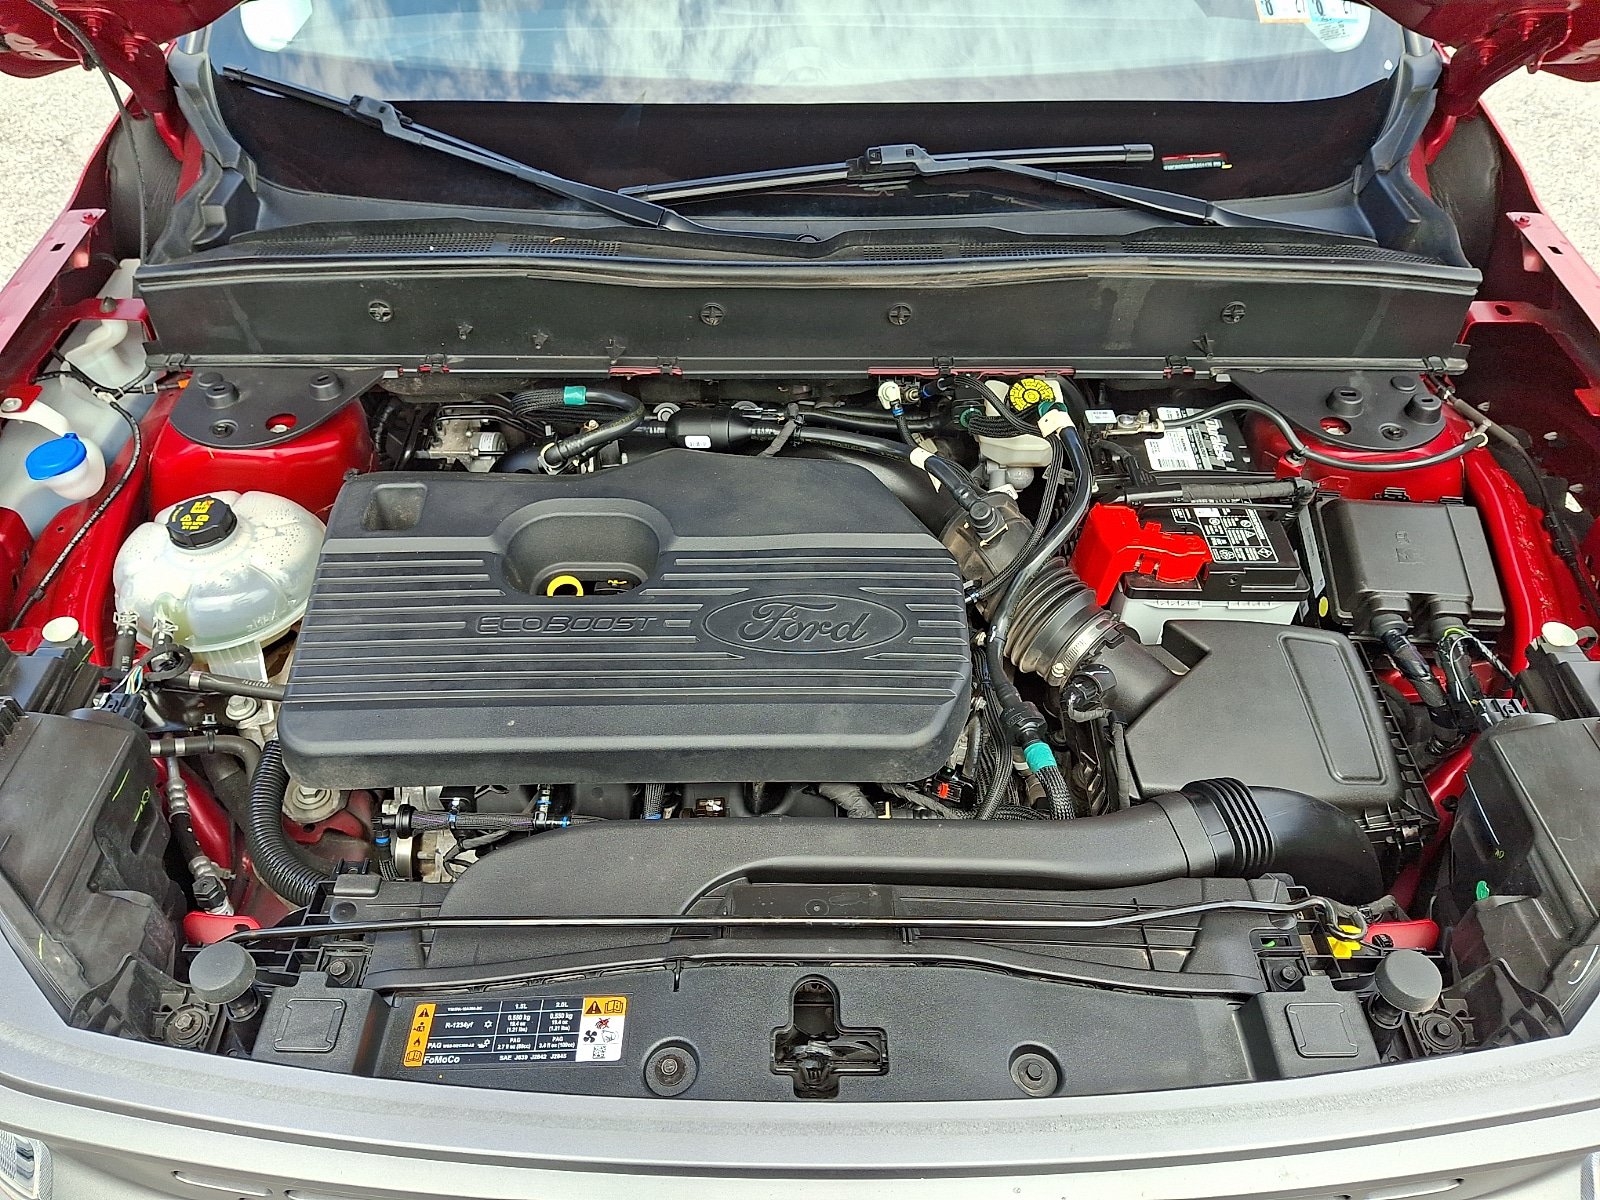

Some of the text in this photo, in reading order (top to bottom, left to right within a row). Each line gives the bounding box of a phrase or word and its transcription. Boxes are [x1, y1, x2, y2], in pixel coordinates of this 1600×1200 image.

[1204, 418, 1232, 462] Duralast
[738, 601, 870, 643] Ford
[445, 1021, 474, 1030] R-1234yf
[427, 1042, 442, 1050] PAG
[423, 1055, 461, 1065] FoMoCo
